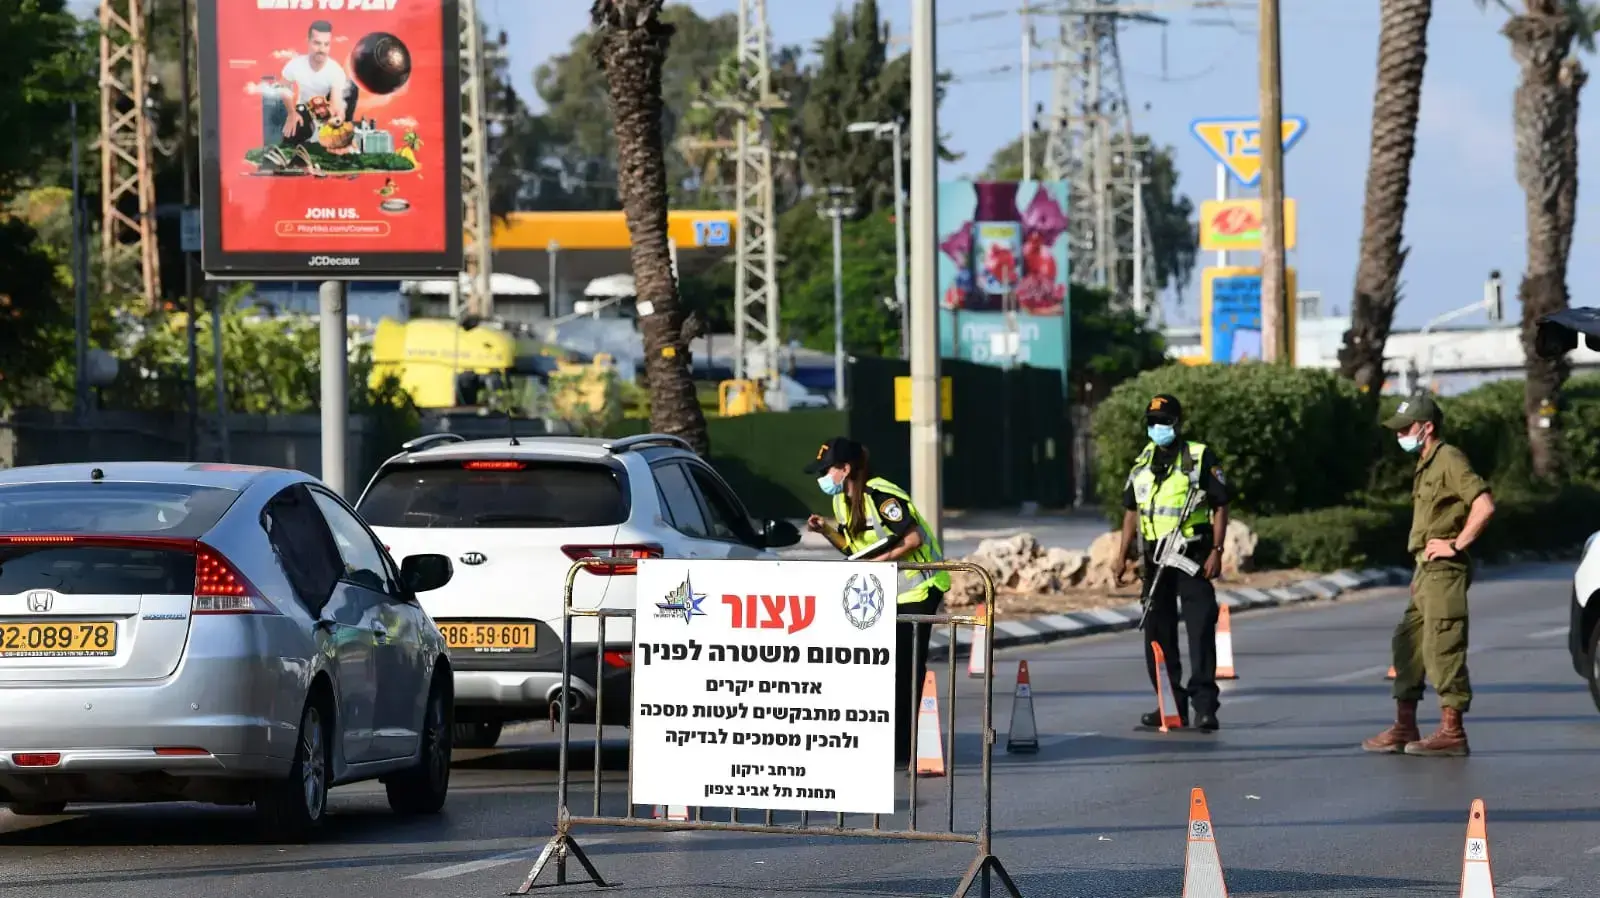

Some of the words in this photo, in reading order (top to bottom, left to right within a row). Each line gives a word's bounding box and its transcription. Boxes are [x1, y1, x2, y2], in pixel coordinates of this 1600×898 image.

[305, 208, 336, 219] JOIN
[337, 208, 360, 219] US.
[308, 256, 360, 266] JCDecaux
[460, 553, 485, 565] KIA
[722, 595, 815, 634] עצור
[639, 640, 702, 665] לפניך
[709, 645, 800, 663] משטרה
[808, 647, 889, 665] מחסום
[707, 680, 753, 696] יקרים
[759, 681, 821, 694] אזרחים
[641, 704, 688, 716] מסכה
[693, 703, 748, 719] לעטות
[753, 707, 840, 723] מתבקשים
[846, 710, 889, 722] הנכם
[666, 729, 728, 746] לבדיקה
[733, 732, 801, 746] מסמכים
[806, 733, 858, 750] ולהכין
[732, 765, 764, 777] ירקון
[768, 766, 805, 776] מרחב
[705, 785, 733, 797] צפון
[738, 786, 769, 796] אביב
[773, 784, 792, 797] תל
[796, 788, 835, 799] תחנת
